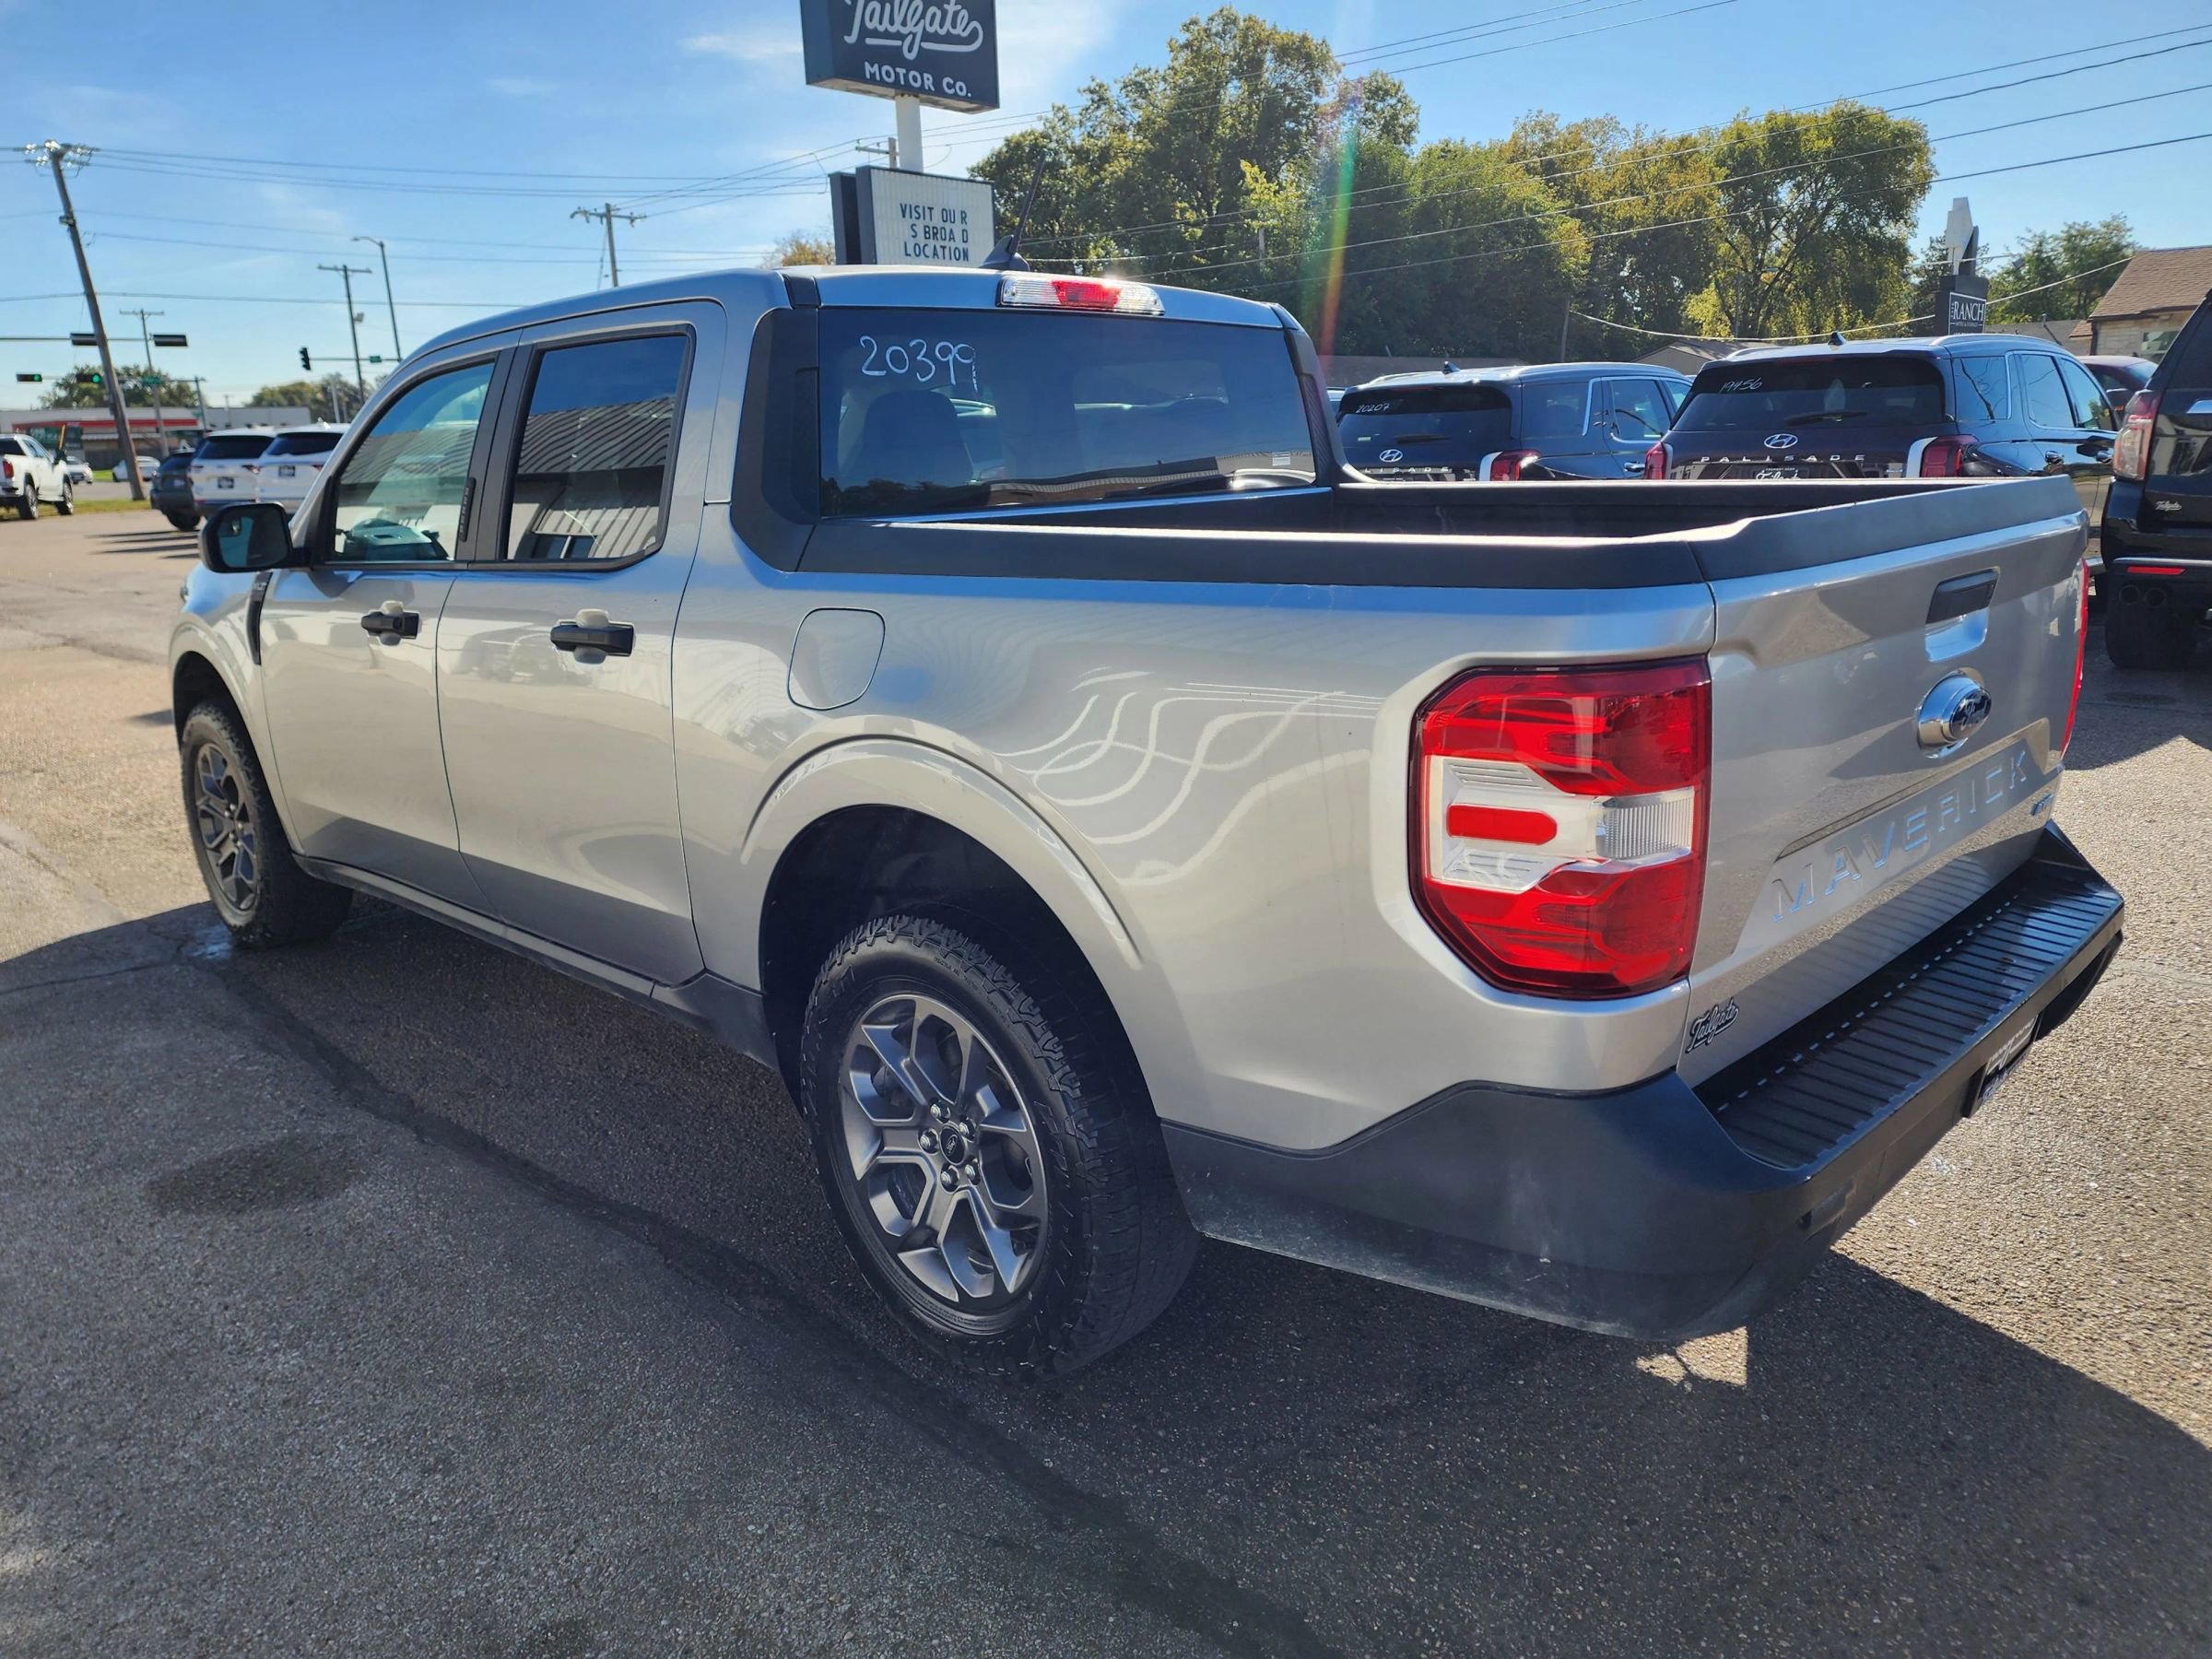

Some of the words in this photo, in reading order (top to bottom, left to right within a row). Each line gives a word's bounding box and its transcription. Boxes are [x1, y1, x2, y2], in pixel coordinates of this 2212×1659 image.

[864, 61, 935, 91] MOTOR
[942, 76, 972, 97] CO.
[900, 203, 935, 222] VISIT
[911, 224, 918, 239] S
[903, 241, 969, 263] LOCATION
[1953, 300, 1984, 322] RANCH
[859, 335, 979, 394] 20399
[1719, 377, 1764, 394] 19456
[1355, 403, 1391, 414] 20207
[1700, 454, 1866, 463] PALISADE
[1771, 749, 2028, 922] MAVERICK
